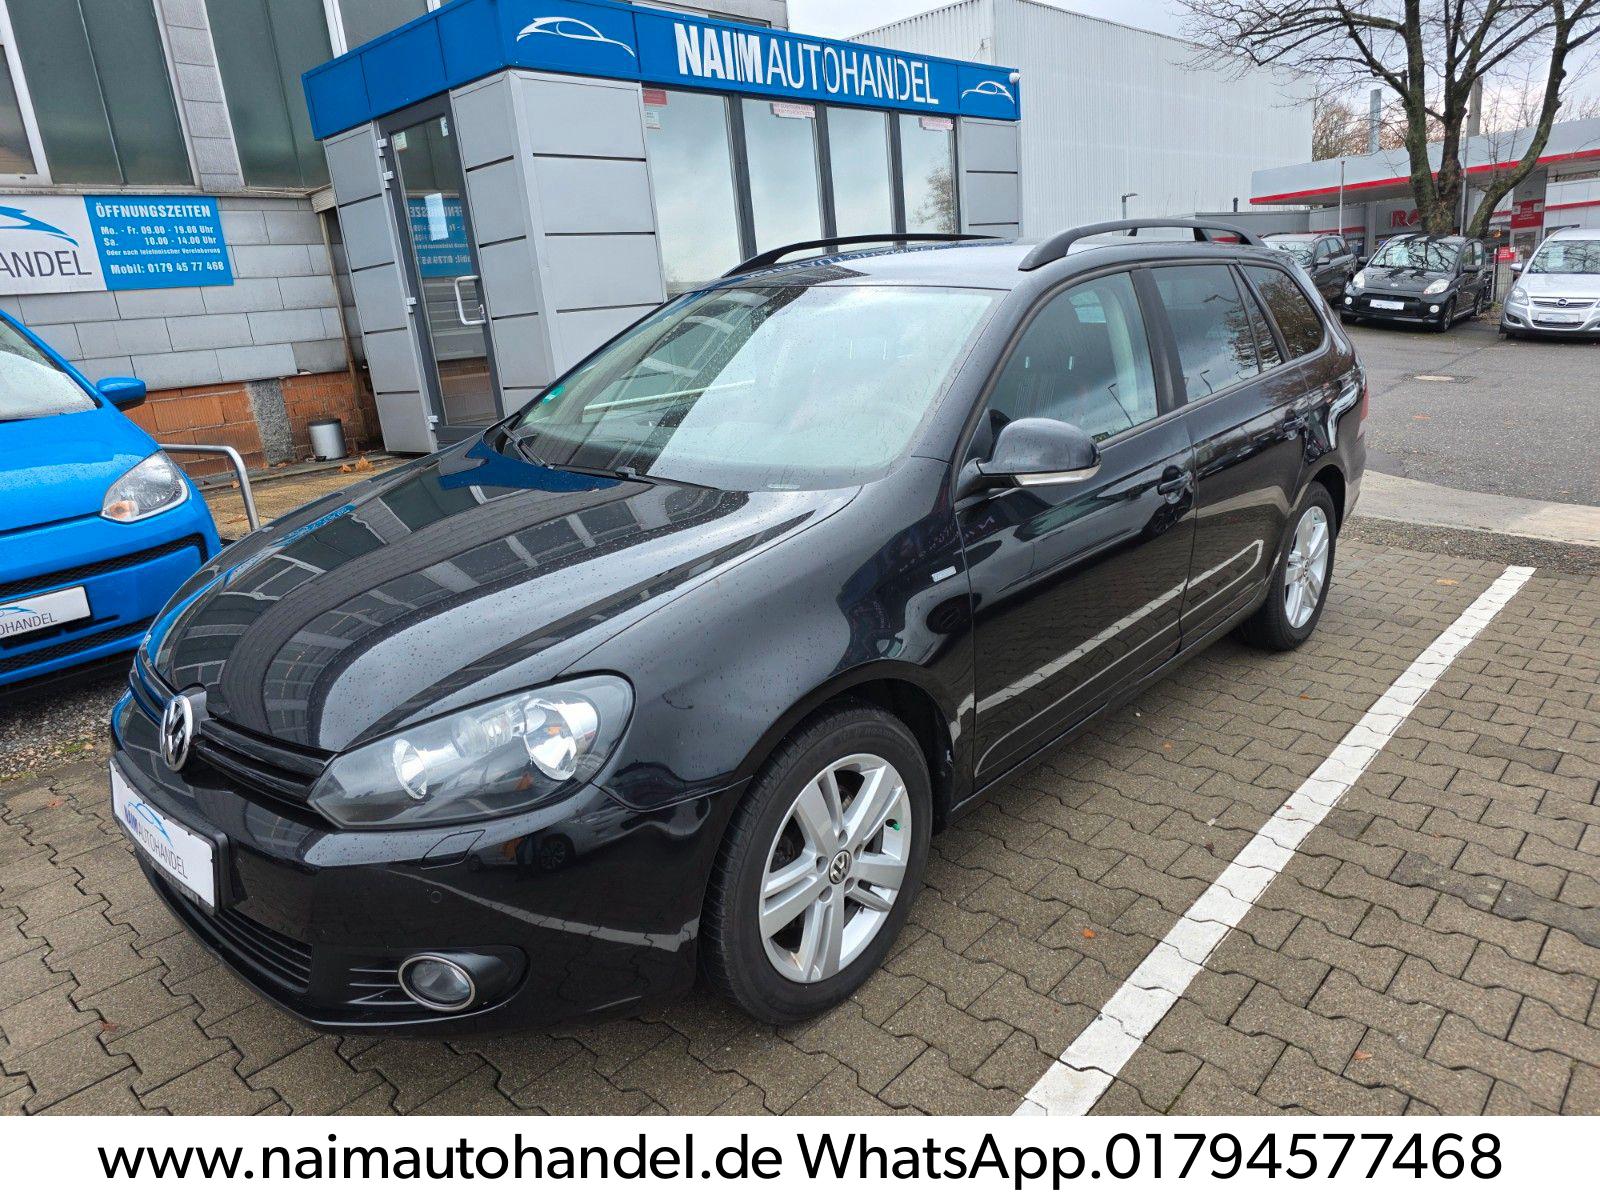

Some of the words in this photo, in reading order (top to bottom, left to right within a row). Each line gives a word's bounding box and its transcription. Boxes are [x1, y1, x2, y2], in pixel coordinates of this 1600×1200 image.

[673, 22, 764, 84] NAIM
[766, 38, 939, 105] AUTOHANDEL
[95, 203, 211, 218] ÖFFNUNGSZEITEN
[100, 226, 118, 235] Mo.
[127, 225, 139, 235] Fr.
[141, 225, 166, 235] 09.00
[200, 225, 214, 234] Uhr
[103, 237, 119, 247] Sa.
[202, 236, 217, 244] Uhr
[110, 263, 146, 275] Mobil:
[147, 262, 173, 273] 0179
[176, 262, 189, 272] 45
[190, 261, 203, 271] 77
[206, 261, 225, 271] 468
